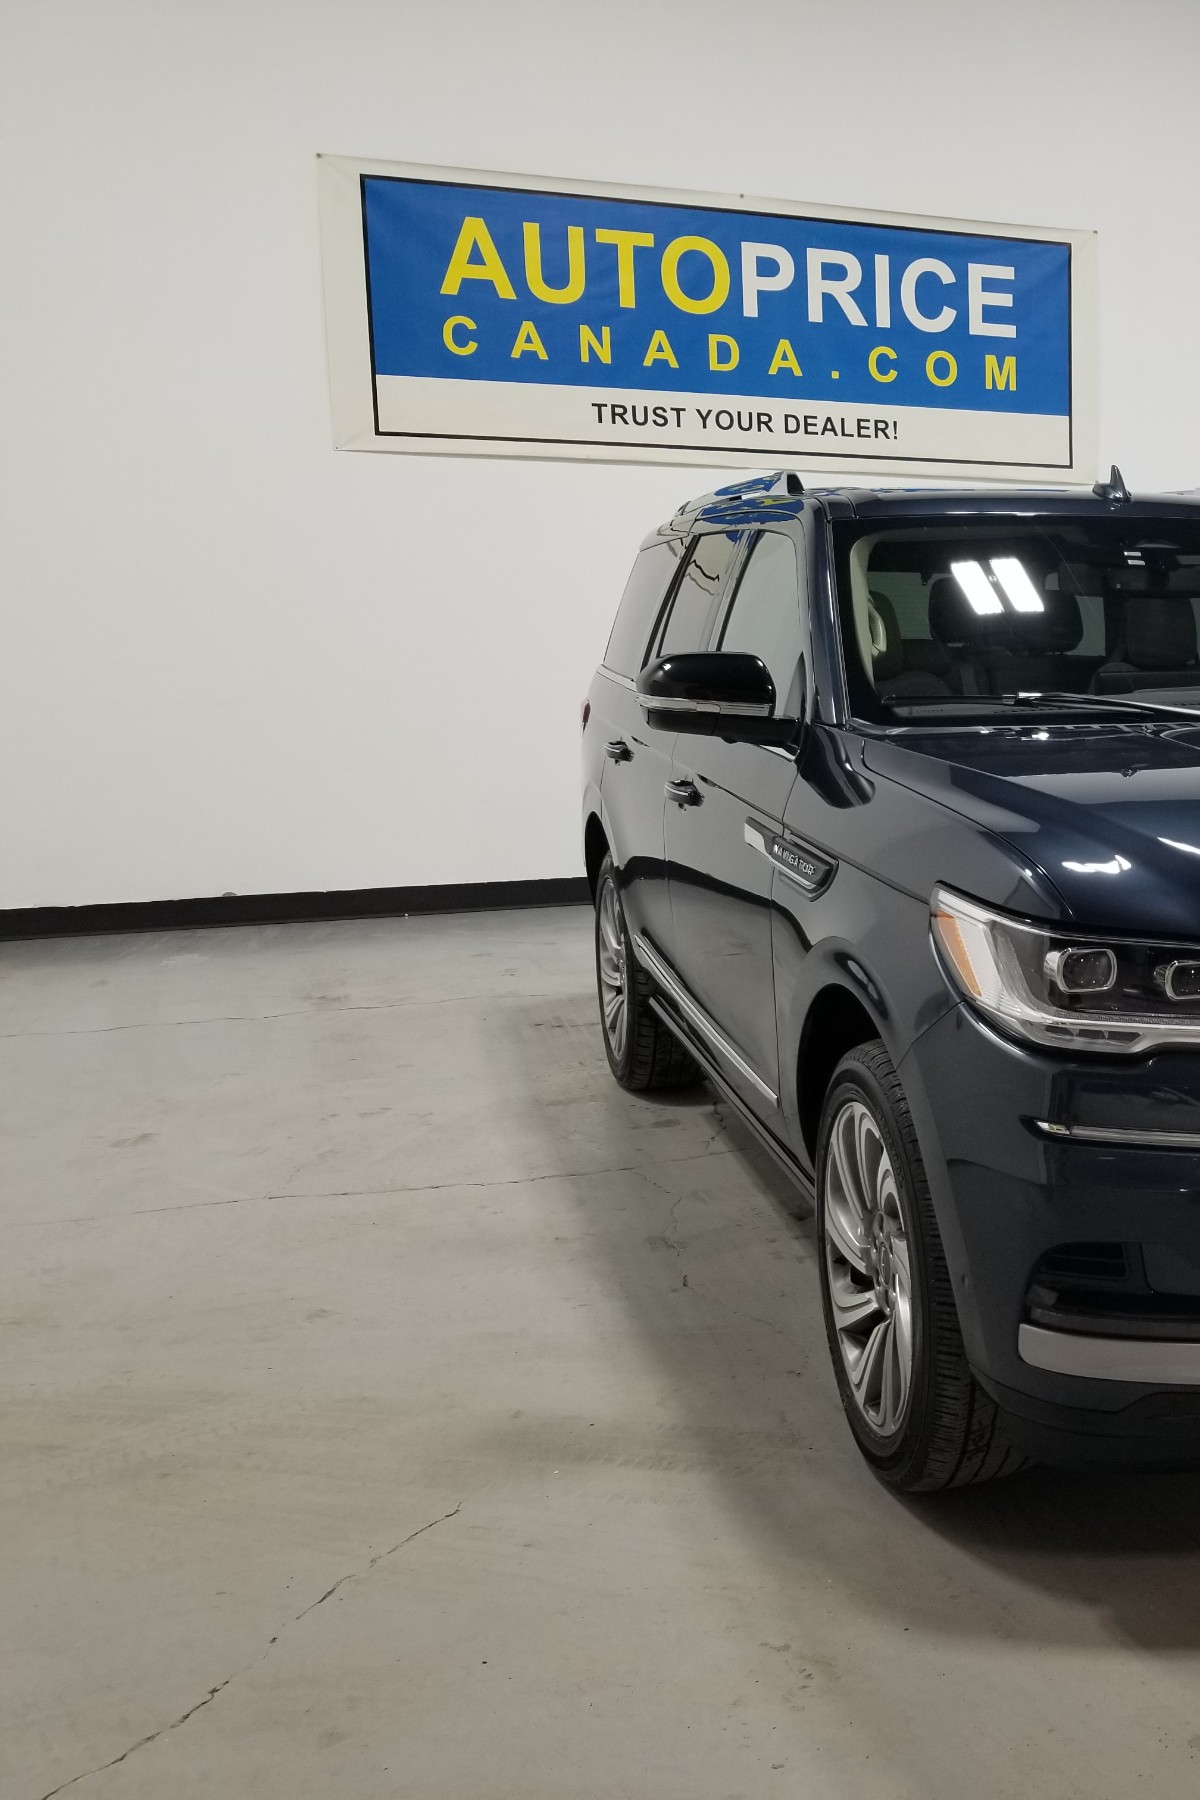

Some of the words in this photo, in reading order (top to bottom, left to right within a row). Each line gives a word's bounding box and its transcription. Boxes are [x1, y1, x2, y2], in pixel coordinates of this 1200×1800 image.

[439, 216, 1017, 339] AUTOPRICE
[442, 315, 1017, 392] CANADA.COM
[591, 402, 687, 428] TRUST
[695, 408, 774, 433] YOUR
[784, 413, 899, 440] DEALER!
[773, 844, 815, 876] NAVIGATOR
